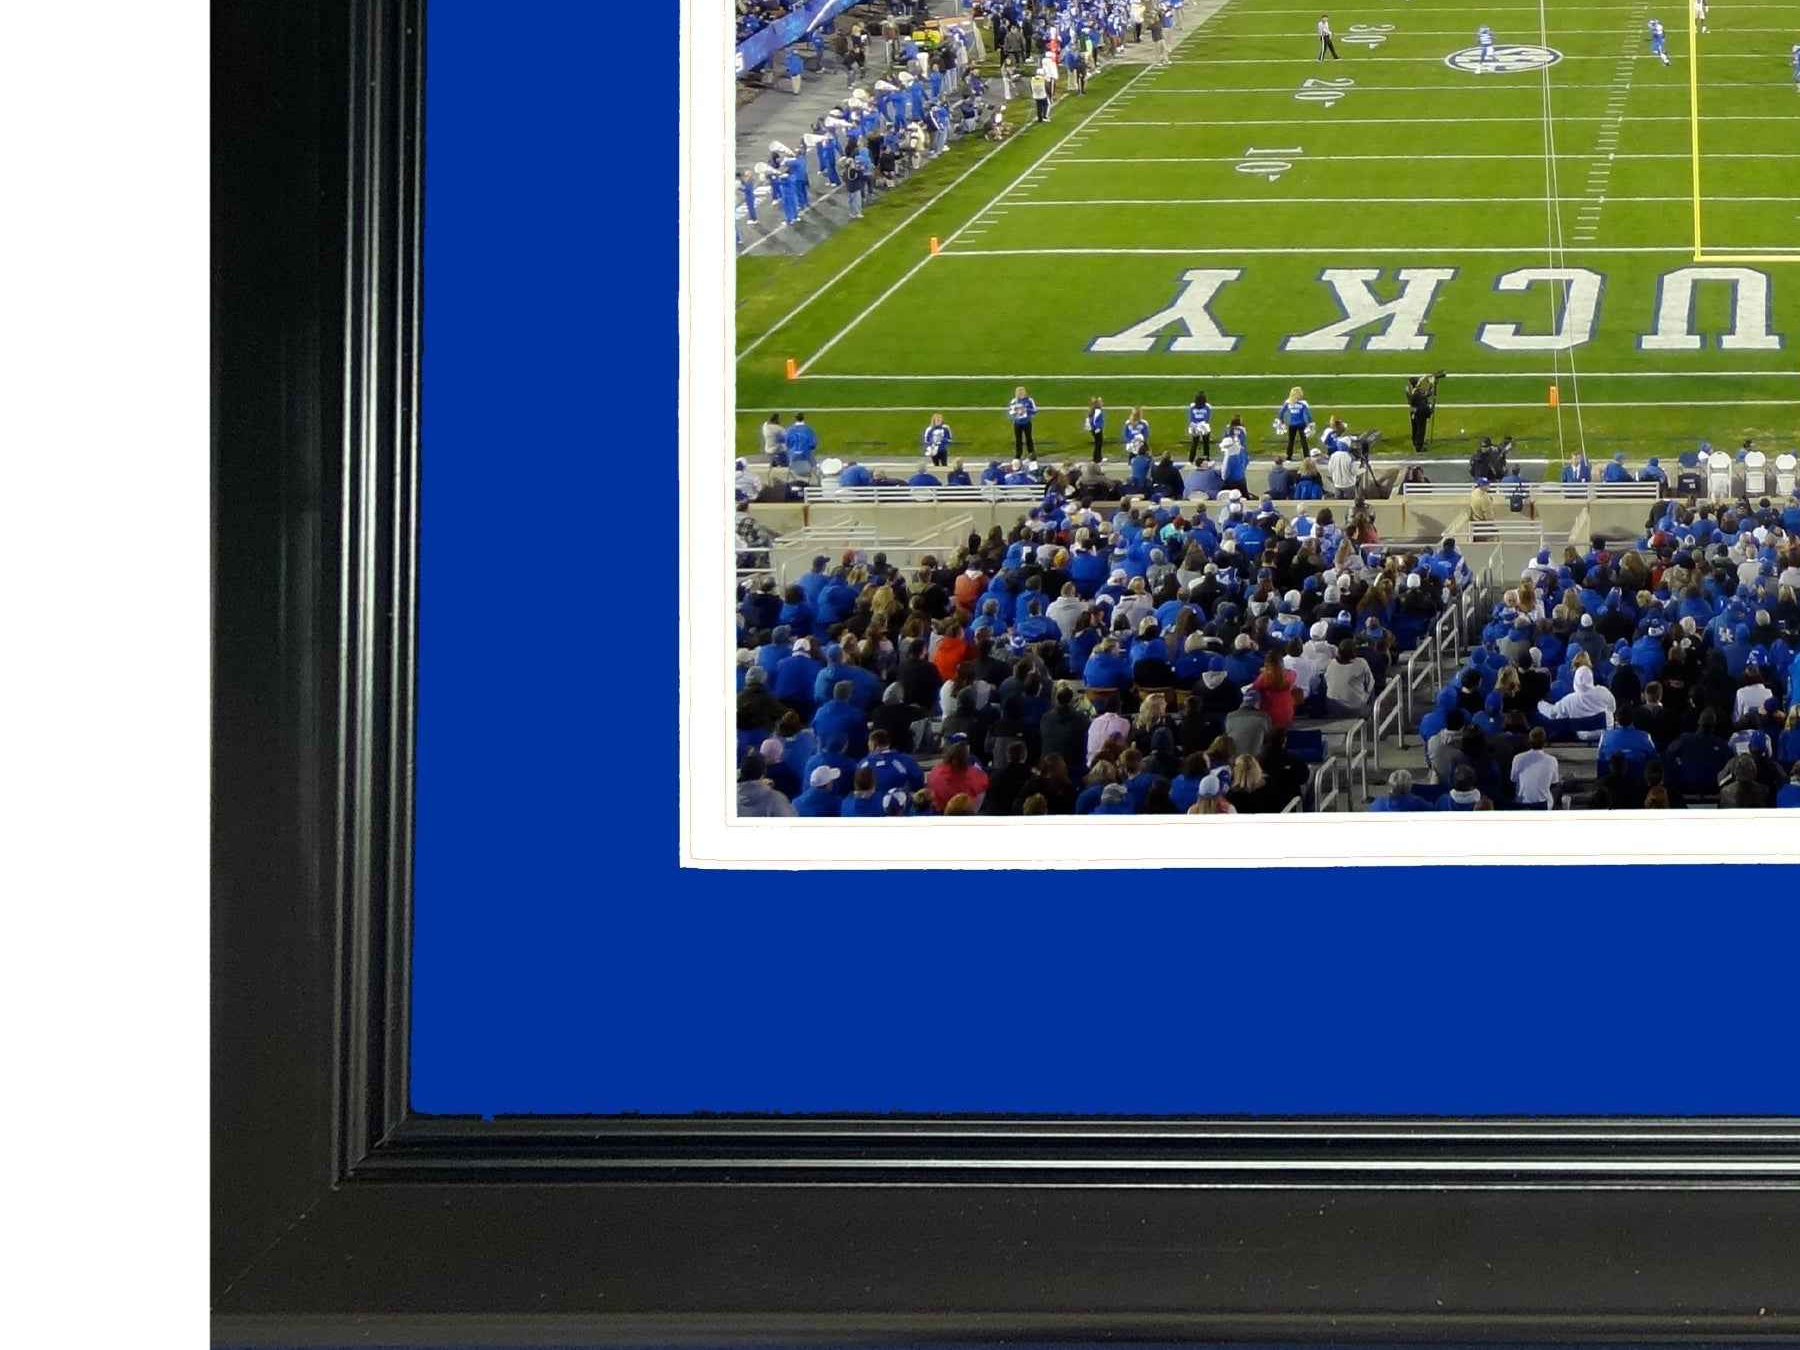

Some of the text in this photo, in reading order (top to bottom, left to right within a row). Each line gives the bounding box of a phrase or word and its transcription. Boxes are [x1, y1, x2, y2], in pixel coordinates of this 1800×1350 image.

[1341, 24, 1396, 43] 30
[1294, 77, 1354, 100] 20
[1235, 146, 1303, 173] 10
